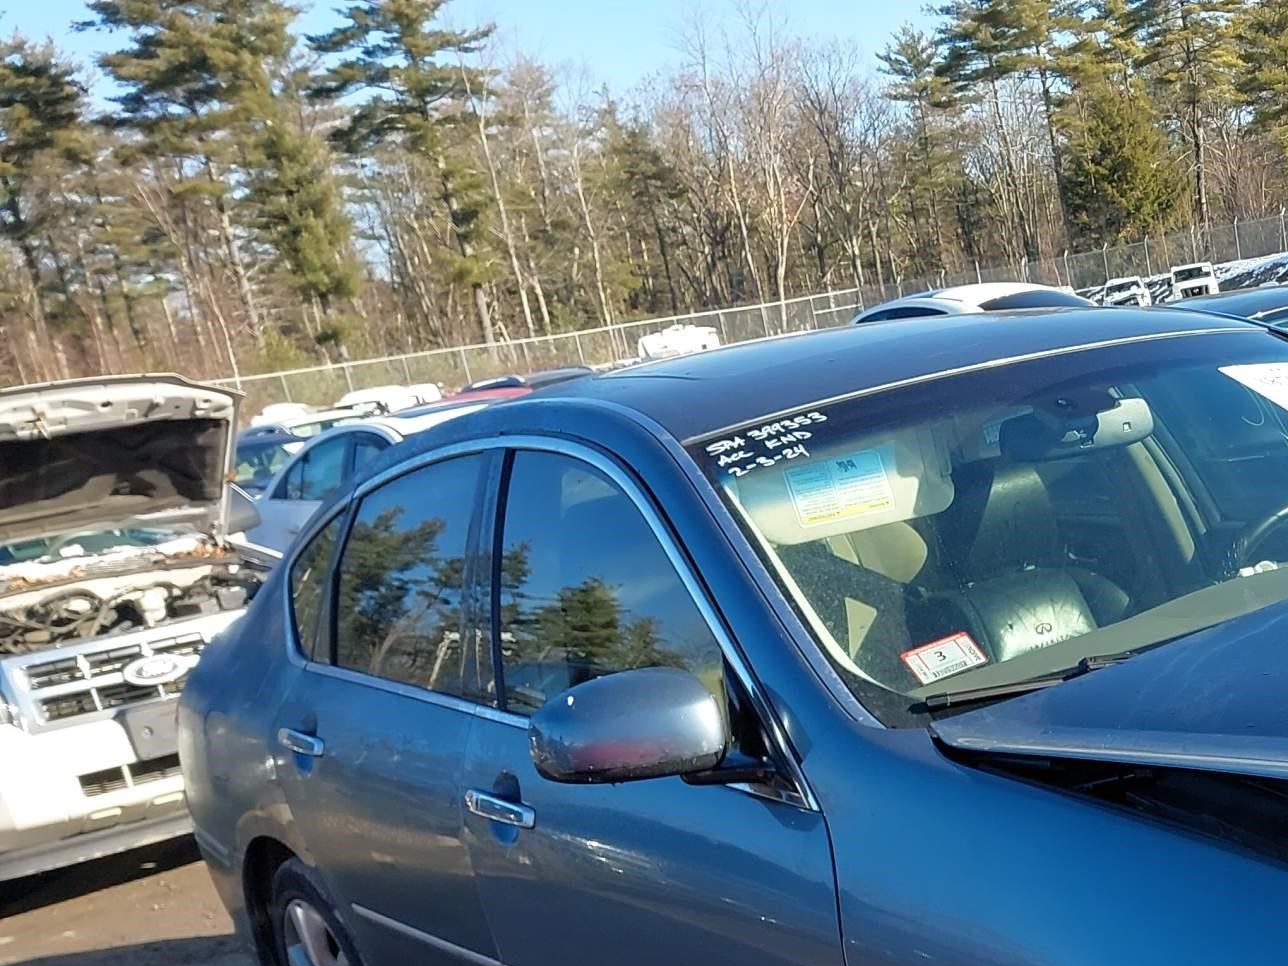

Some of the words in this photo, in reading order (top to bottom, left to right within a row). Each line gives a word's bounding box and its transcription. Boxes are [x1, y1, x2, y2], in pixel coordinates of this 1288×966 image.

[747, 411, 828, 440] 399353
[728, 444, 810, 477] 2-3-24
[933, 650, 947, 662] 3
